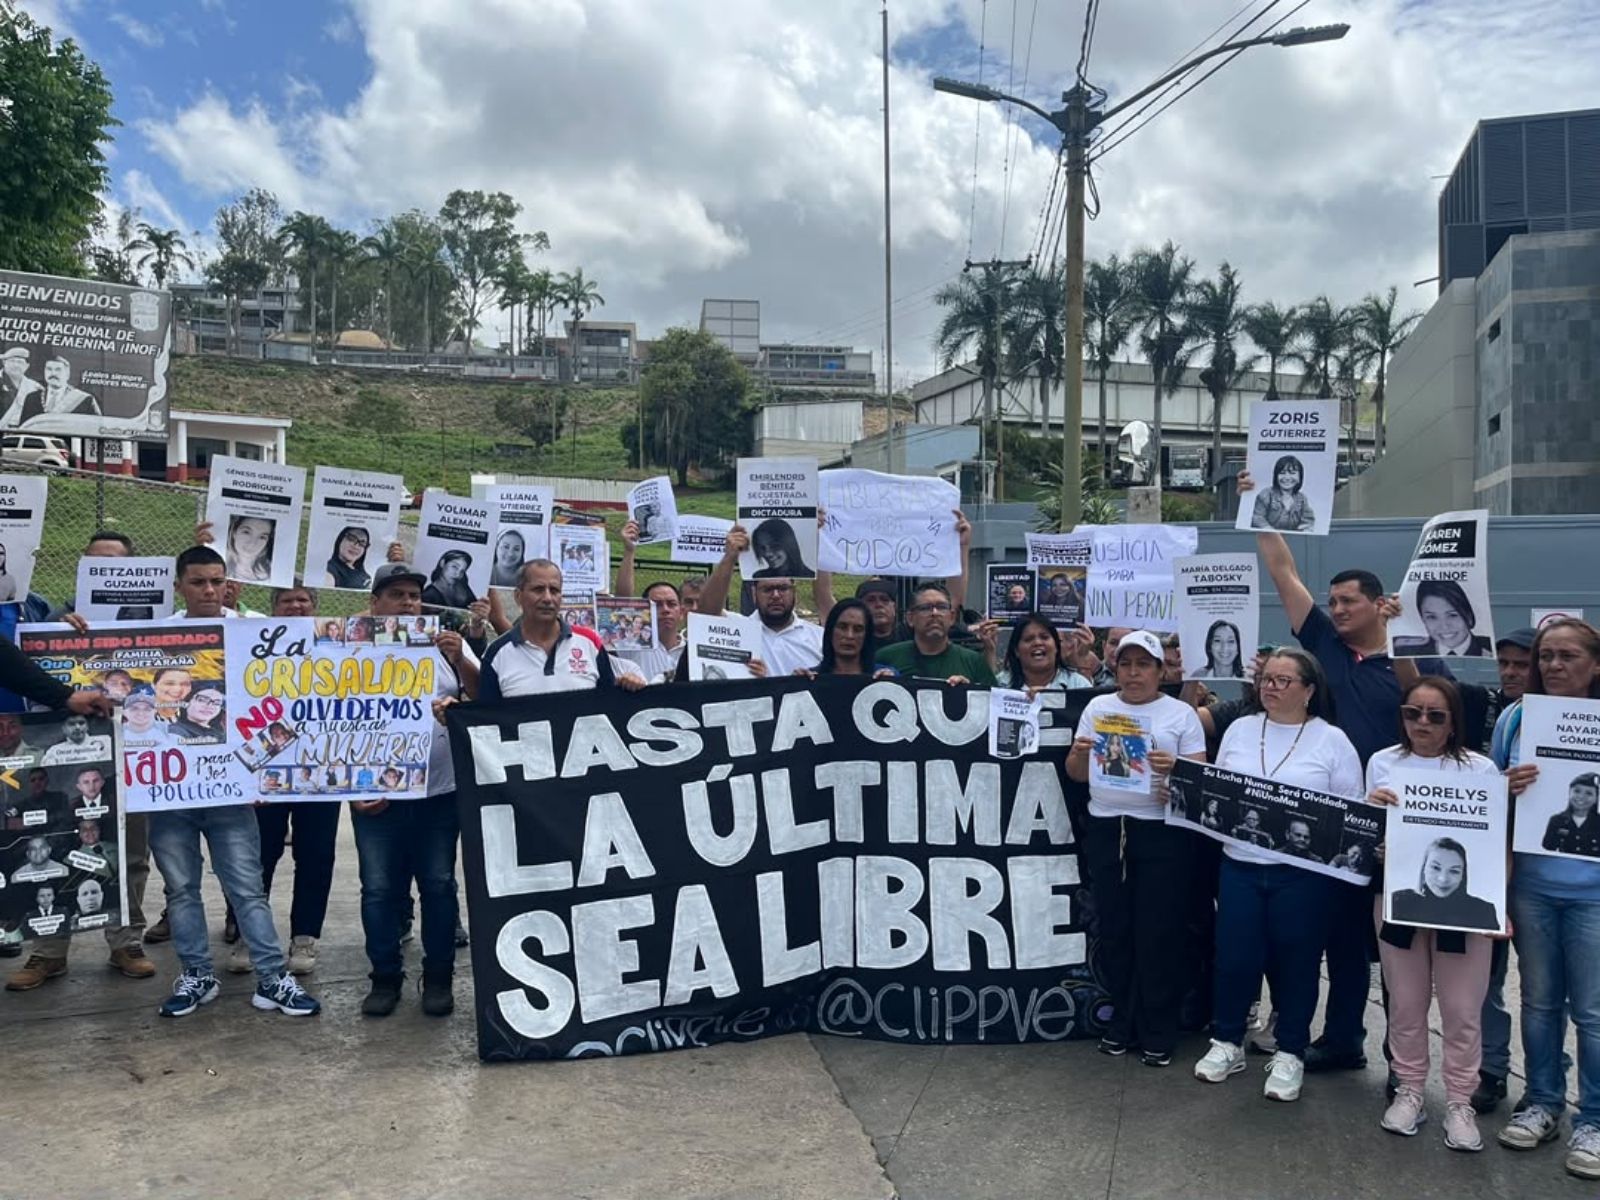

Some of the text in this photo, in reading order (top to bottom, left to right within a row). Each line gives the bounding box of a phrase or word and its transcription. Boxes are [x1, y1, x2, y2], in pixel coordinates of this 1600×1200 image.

[0, 282, 122, 310] BIENVENIDOS
[44, 321, 112, 341] NACIONAL
[116, 329, 136, 342] DE
[42, 334, 115, 352] FEMENINA
[1268, 412, 1320, 424] ZORIS
[1260, 429, 1326, 438] GUTIERREZ
[500, 493, 539, 502] LILIANA
[747, 491, 808, 500] SECUESTRADA
[437, 503, 488, 519] YOLIMAR
[500, 503, 542, 512] UTIERREZ
[750, 509, 803, 517] DICTADURA
[1425, 528, 1461, 540] KAREN
[677, 544, 707, 553] NUNCA
[836, 535, 939, 571] TOD@S
[1095, 536, 1164, 562] USTICIA
[89, 567, 169, 577] BETZABETH
[1105, 569, 1135, 581] PARA
[1181, 564, 1253, 573] MARÍA DELGADO
[1409, 571, 1421, 581] EN
[1424, 571, 1435, 580] EL
[1193, 574, 1243, 582] TABOSKY
[1087, 586, 1112, 617] VIN
[708, 625, 741, 637] MIRLA
[49, 637, 90, 650] HAN
[92, 636, 133, 649] SIDO
[135, 633, 220, 647] LIBERADO
[251, 625, 309, 659] La
[116, 650, 162, 659] FAMILIA
[236, 696, 423, 741] NO OLVIDEMOS
[1562, 712, 1600, 722] KAREN
[295, 720, 391, 733] a nuestras
[467, 681, 1073, 785] HASTA QUE
[295, 732, 430, 766] MUJERES
[196, 753, 234, 775] para
[1202, 767, 1215, 777] Su
[1216, 770, 1243, 784] Lucha
[1244, 776, 1274, 791] Nunca
[1278, 785, 1301, 798] Será
[1302, 791, 1348, 810] Olvidada
[1405, 784, 1488, 802] NORELYS
[1405, 800, 1488, 816] MONSALVE
[1344, 810, 1379, 829] Vente
[480, 759, 1076, 898] LA ÚLTIMA
[496, 854, 1087, 1039] SEA LIBRE
